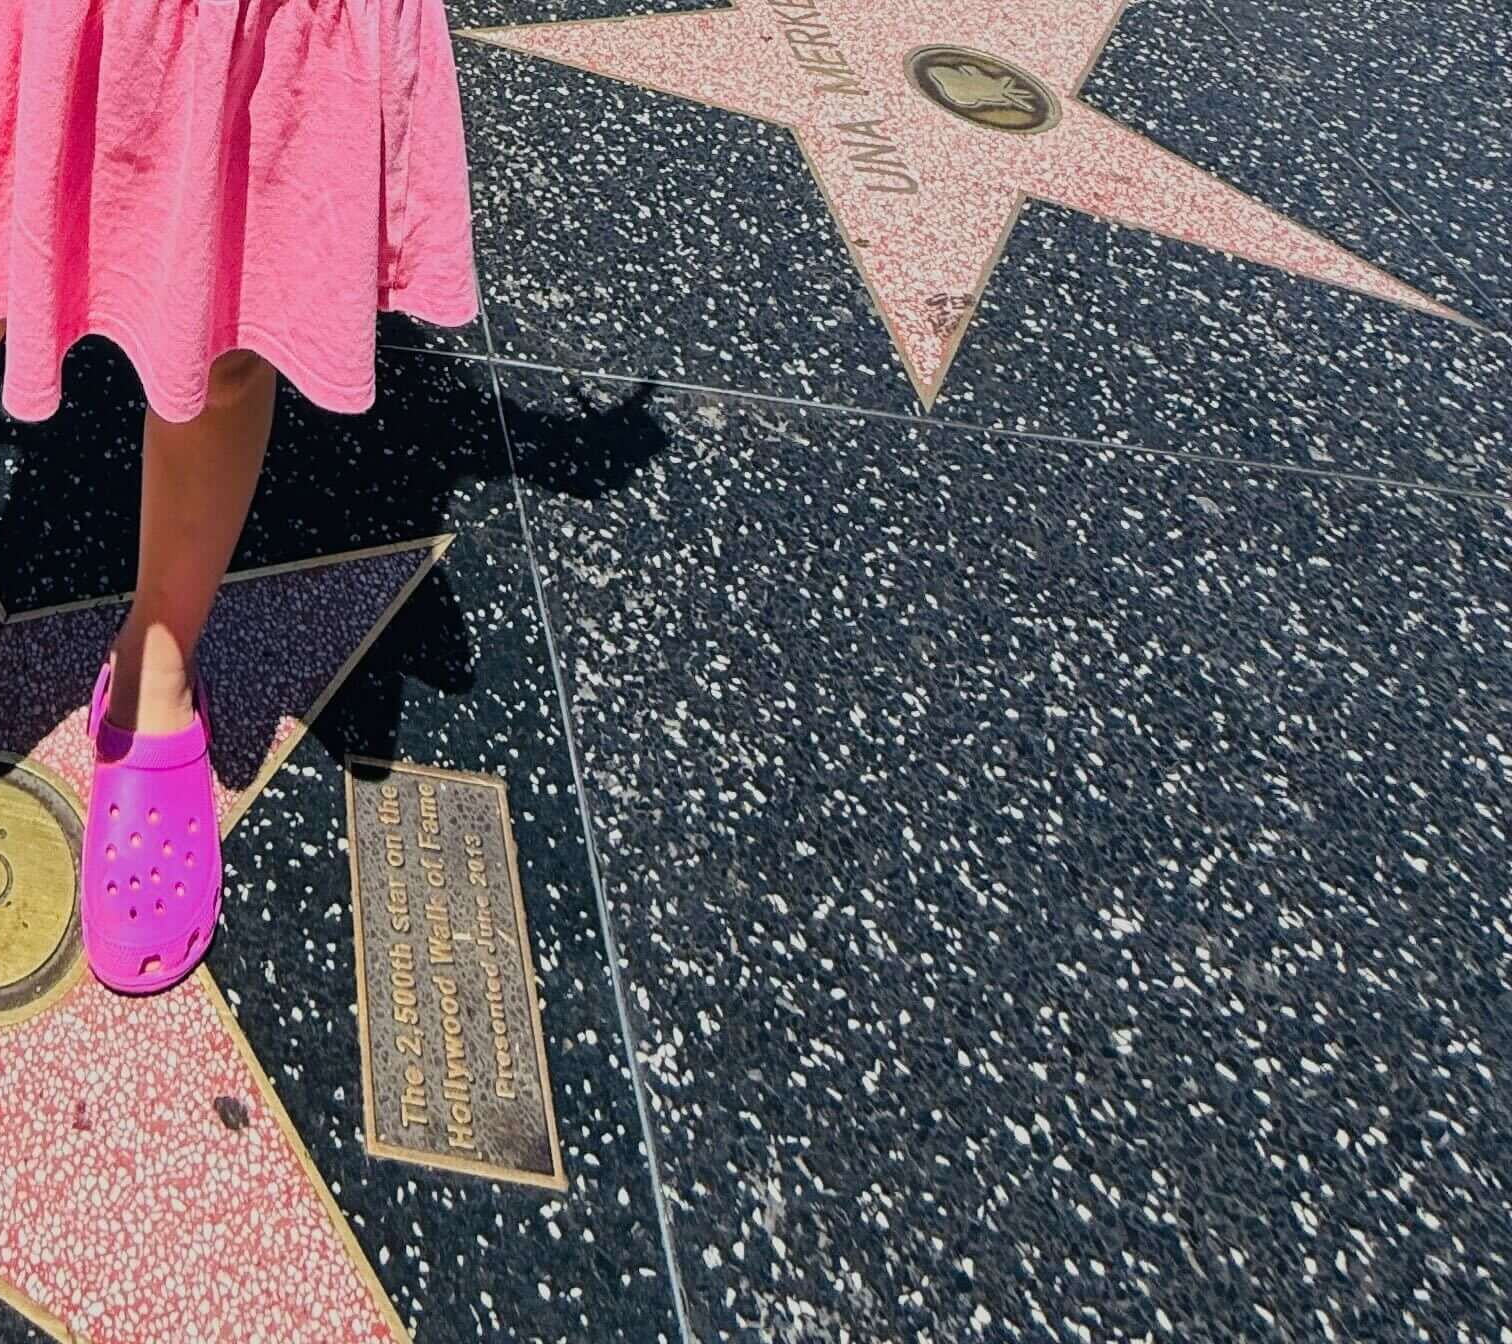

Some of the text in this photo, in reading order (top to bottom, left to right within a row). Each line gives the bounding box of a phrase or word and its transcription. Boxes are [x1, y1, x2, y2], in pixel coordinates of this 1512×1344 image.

[834, 119, 919, 195] UNA
[377, 784, 429, 1127] The 2,500th star on the
[418, 783, 475, 1150] Hollywood Walk of Fame
[463, 832, 517, 1100] Presented June 2013
